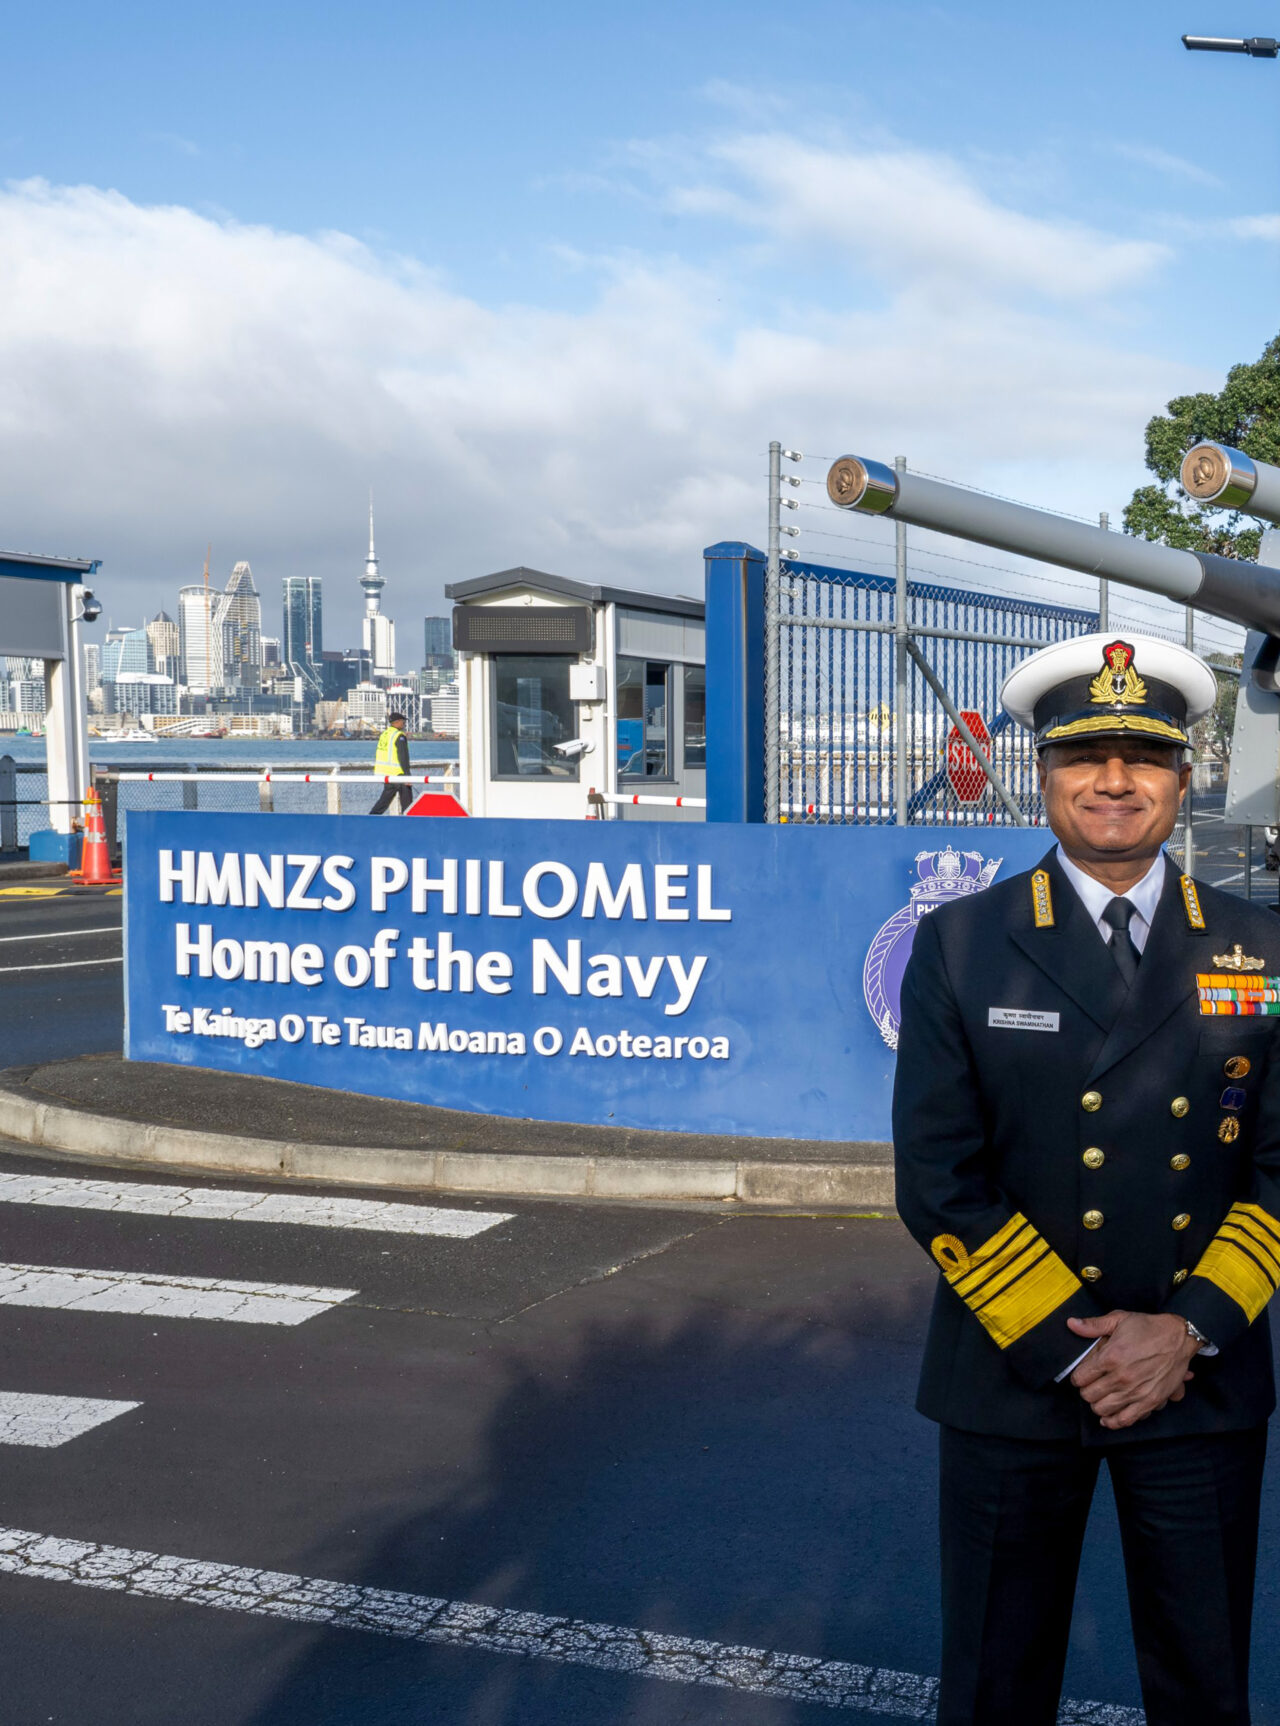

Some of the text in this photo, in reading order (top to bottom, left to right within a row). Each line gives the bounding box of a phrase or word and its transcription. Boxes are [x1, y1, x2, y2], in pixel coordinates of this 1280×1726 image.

[159, 849, 733, 922] HMNZS PHILOMEL
[175, 922, 709, 1016] Home of the Navy
[161, 1004, 731, 1060] Te Kainga O Te Taua Moana O Aotearoa
[1016, 1020, 1054, 1028] SWAMINATHAN
